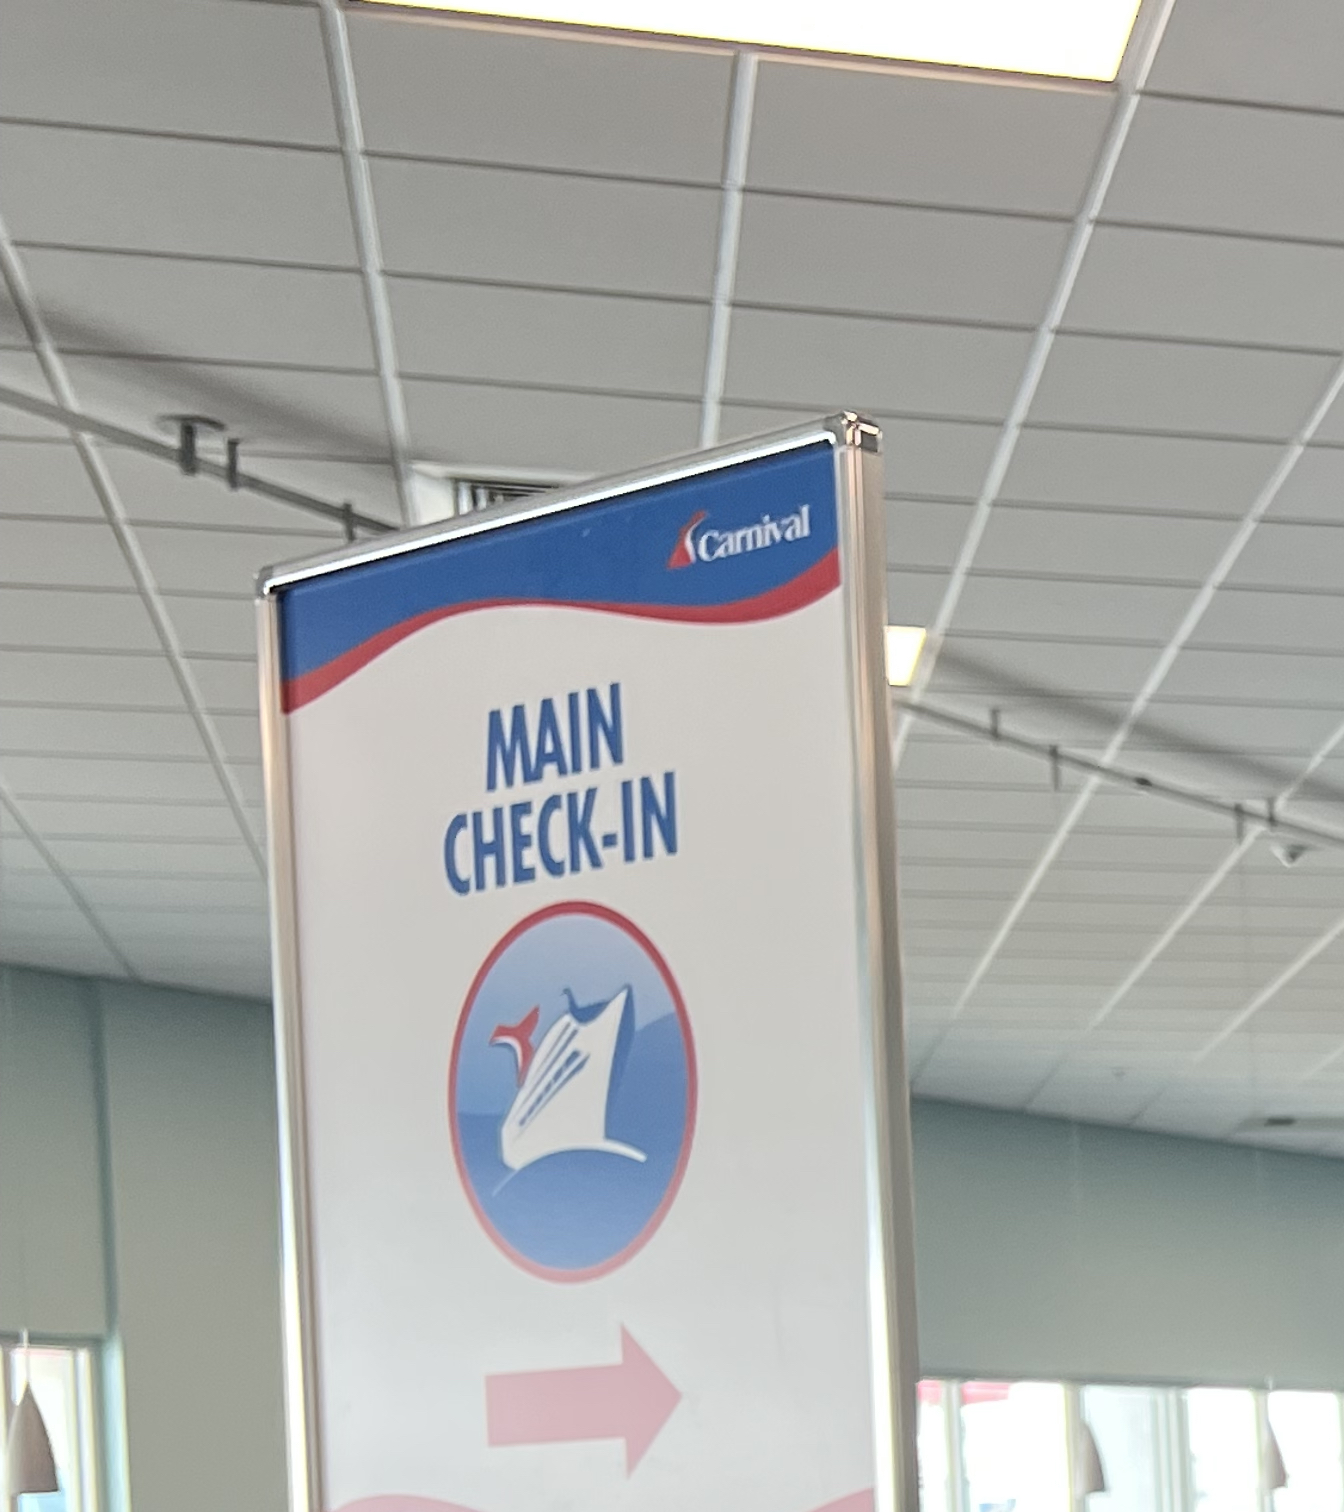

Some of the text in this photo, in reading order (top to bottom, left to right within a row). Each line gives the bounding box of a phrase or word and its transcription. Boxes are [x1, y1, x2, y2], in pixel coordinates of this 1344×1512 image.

[698, 503, 811, 562] Carnival
[486, 682, 624, 793] MAIN
[444, 771, 678, 896] CHECK-IN
